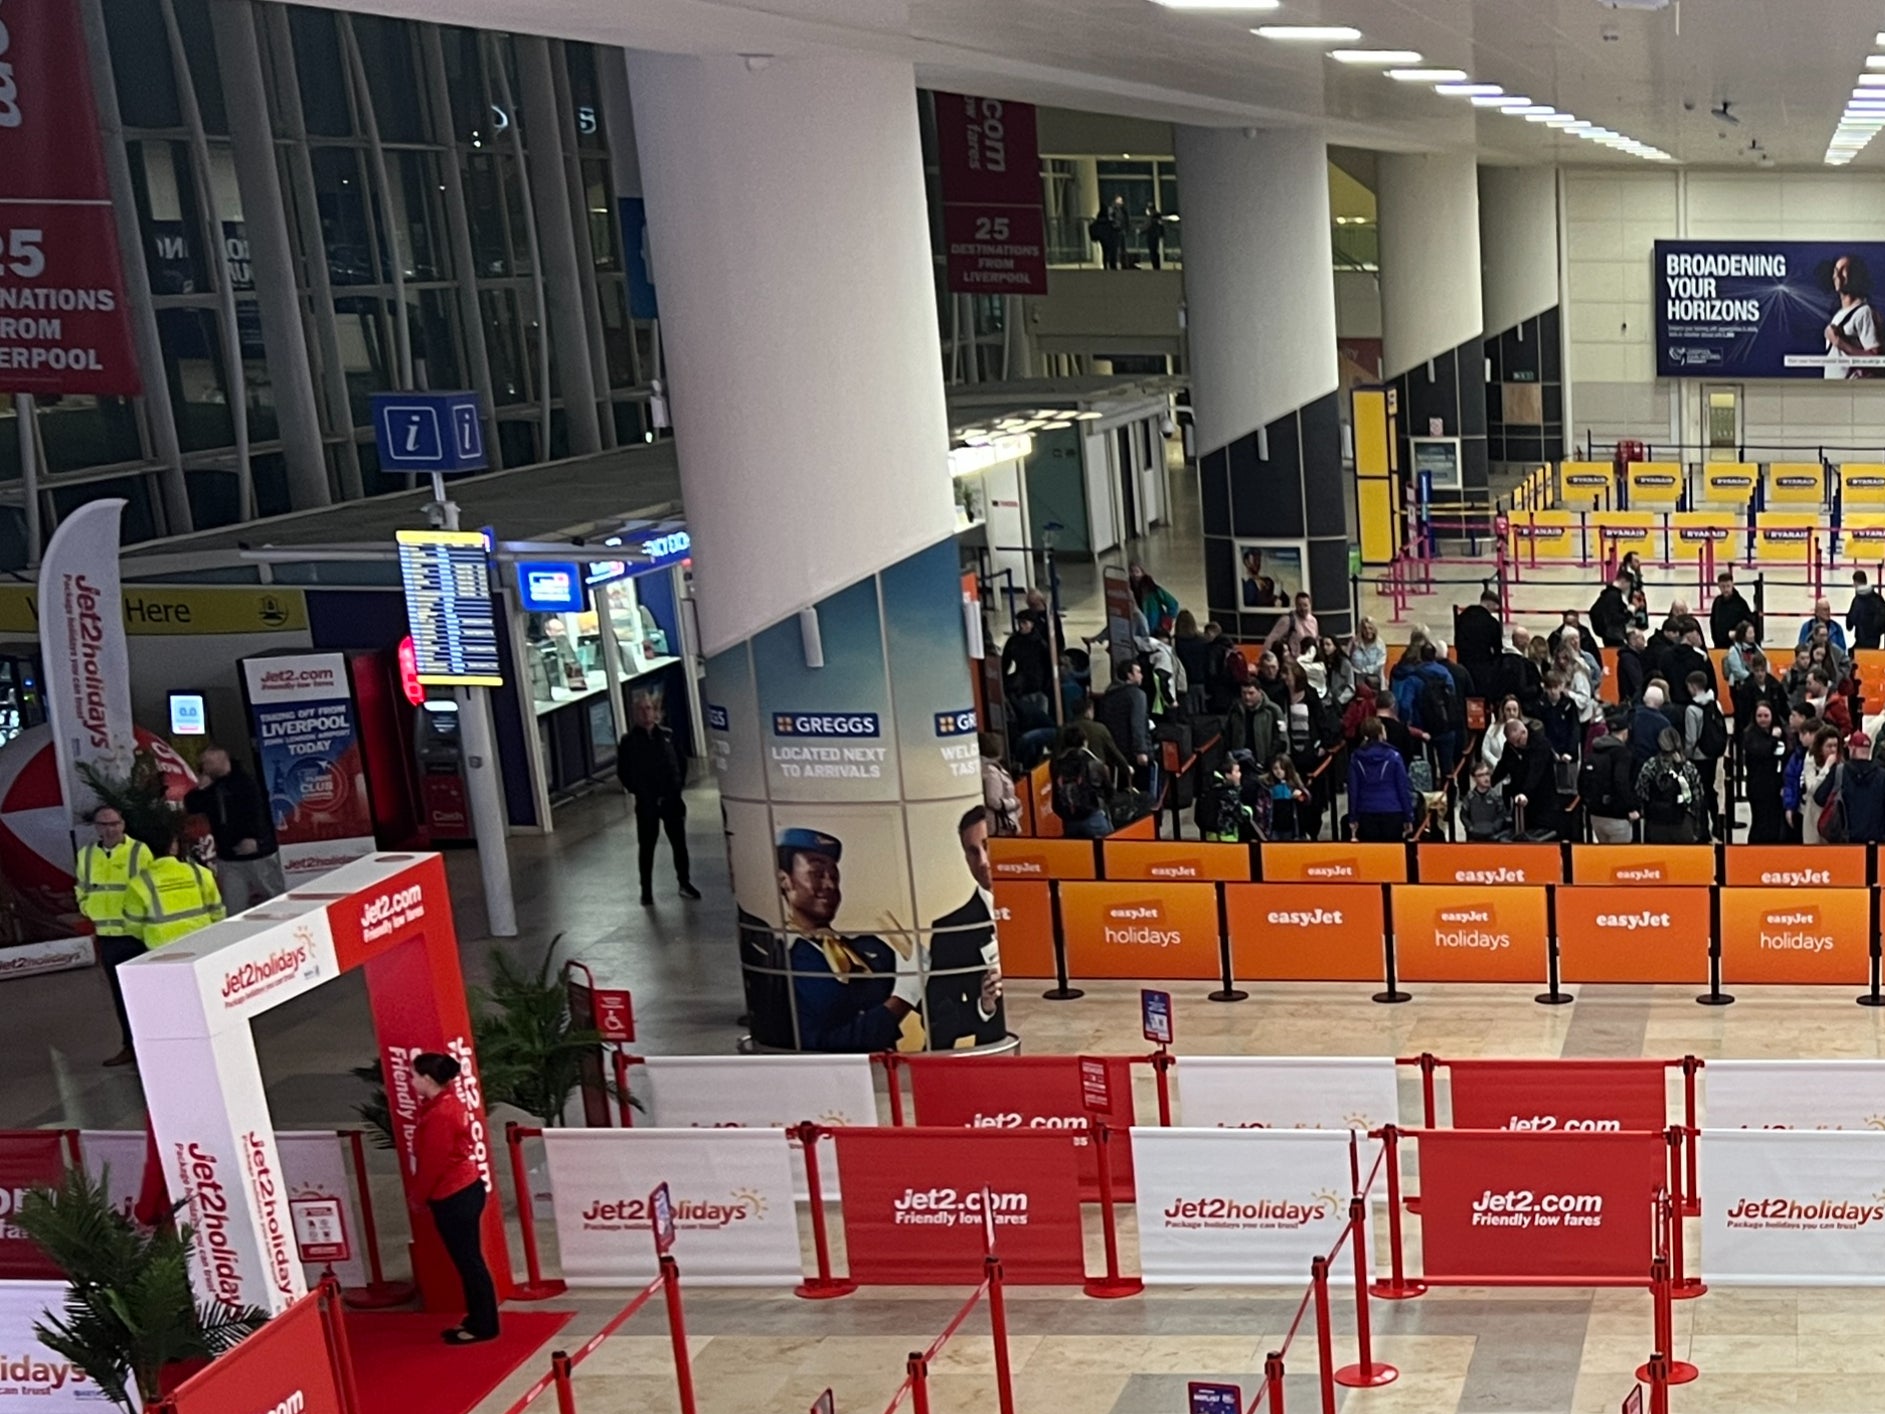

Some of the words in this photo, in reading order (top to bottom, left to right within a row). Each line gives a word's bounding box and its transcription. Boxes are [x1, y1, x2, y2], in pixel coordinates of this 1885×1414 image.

[974, 217, 1010, 241] 25
[0, 229, 45, 278] 5
[951, 243, 1040, 257] DESTINATIONS
[978, 257, 1015, 270] FROM
[1666, 254, 1786, 277] BROADENING
[963, 271, 1031, 285] LIVERPOOL
[1667, 278, 1717, 299] YOUR
[1667, 299, 1760, 321] HORIZONS
[125, 598, 191, 623] Here
[74, 574, 109, 748] Jet2holidays
[262, 715, 350, 738] LIVERPOOL
[797, 717, 875, 734] GREGGS
[287, 740, 332, 756] TODAY
[772, 746, 839, 762] LOCATED
[844, 747, 886, 763] NEXT
[780, 764, 801, 778] TO
[803, 764, 881, 779] ARRIVALS
[1151, 865, 1196, 878] easyJet
[1307, 865, 1352, 878] easyJet
[1455, 867, 1525, 884] easyJet
[1616, 868, 1661, 881] easyJet
[1761, 869, 1830, 886] easyJet
[361, 883, 422, 928] Jet2.com
[1110, 908, 1158, 920] easyJet
[1267, 908, 1343, 926] easyJet
[1441, 910, 1488, 923] easyJet
[1595, 911, 1670, 929] easyJet
[1766, 913, 1814, 925] easyJet
[1105, 926, 1181, 946] holidays
[1435, 929, 1510, 951] holidays
[1760, 931, 1834, 952] holidays
[222, 945, 307, 998] Jet2holidays
[1472, 1189, 1602, 1213] Jet2.com
[895, 1211, 956, 1227] Friendly
[994, 1211, 1028, 1225] ares
[1164, 1197, 1325, 1225] Jet2holidays
[1727, 1198, 1885, 1226] Jet2holidays
[1472, 1213, 1531, 1229] Friendly
[1534, 1213, 1560, 1226] low
[1563, 1213, 1601, 1227] fares
